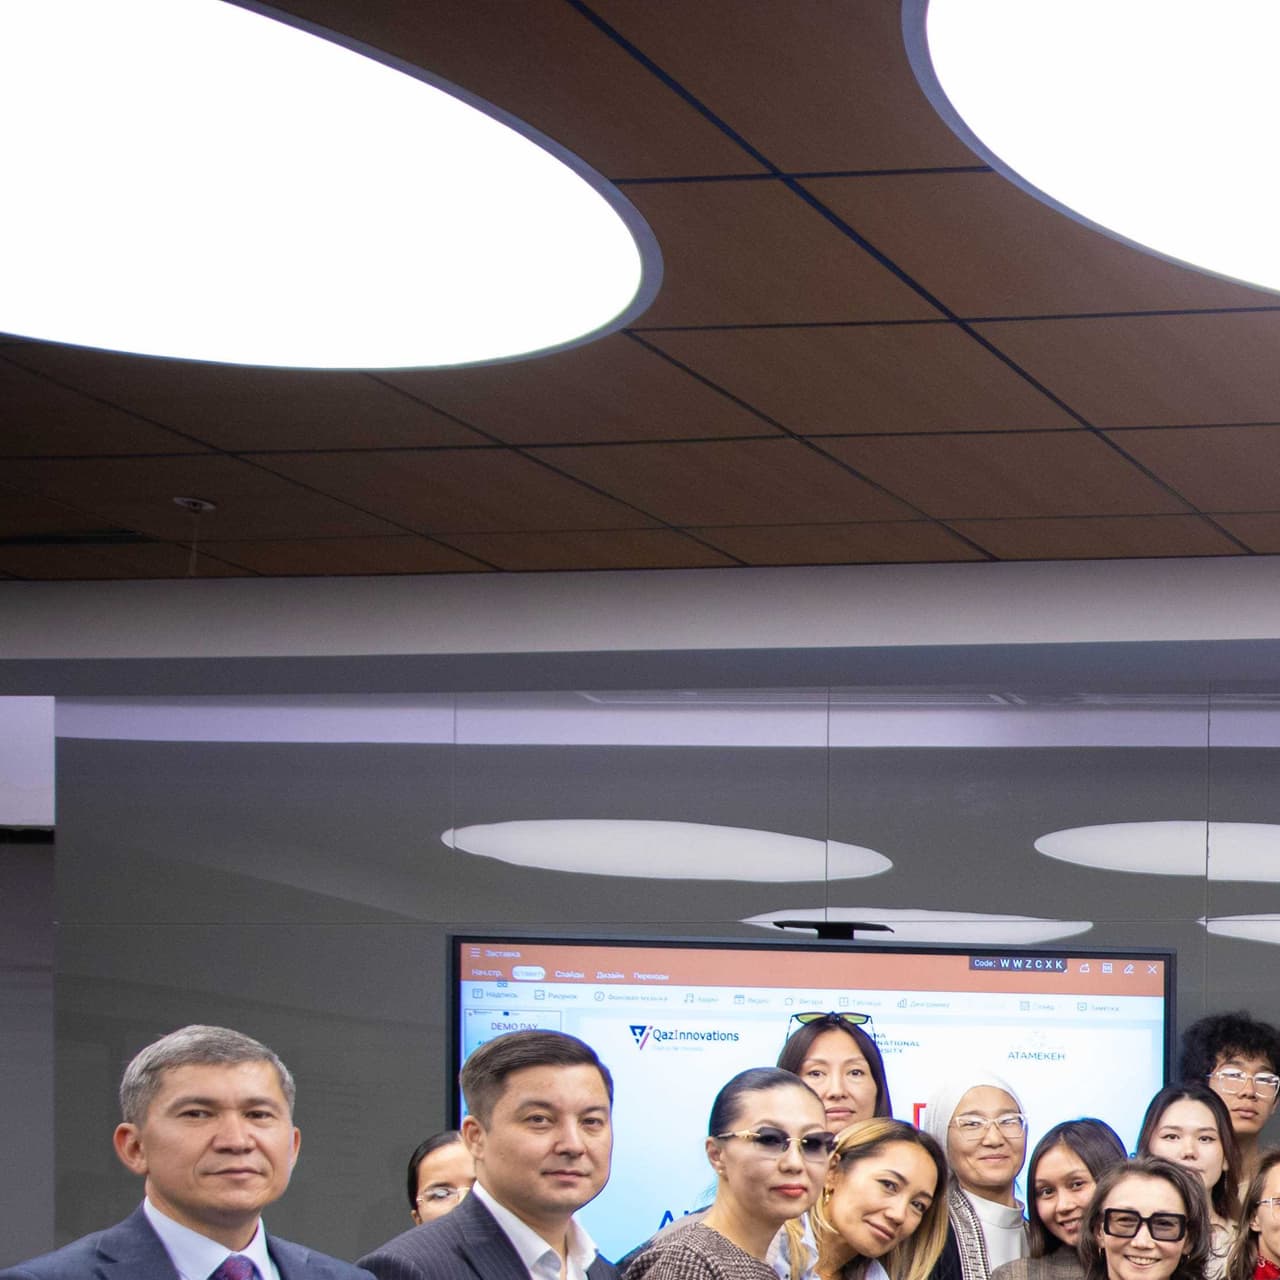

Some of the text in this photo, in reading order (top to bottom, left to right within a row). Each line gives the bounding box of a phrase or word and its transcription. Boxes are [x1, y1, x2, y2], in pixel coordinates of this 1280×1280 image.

[974, 959, 996, 968] Code:
[491, 1022, 518, 1031] DEMO
[652, 1029, 740, 1042] QazInnovations
[1008, 1051, 1066, 1061] АТАМЕКЕН
